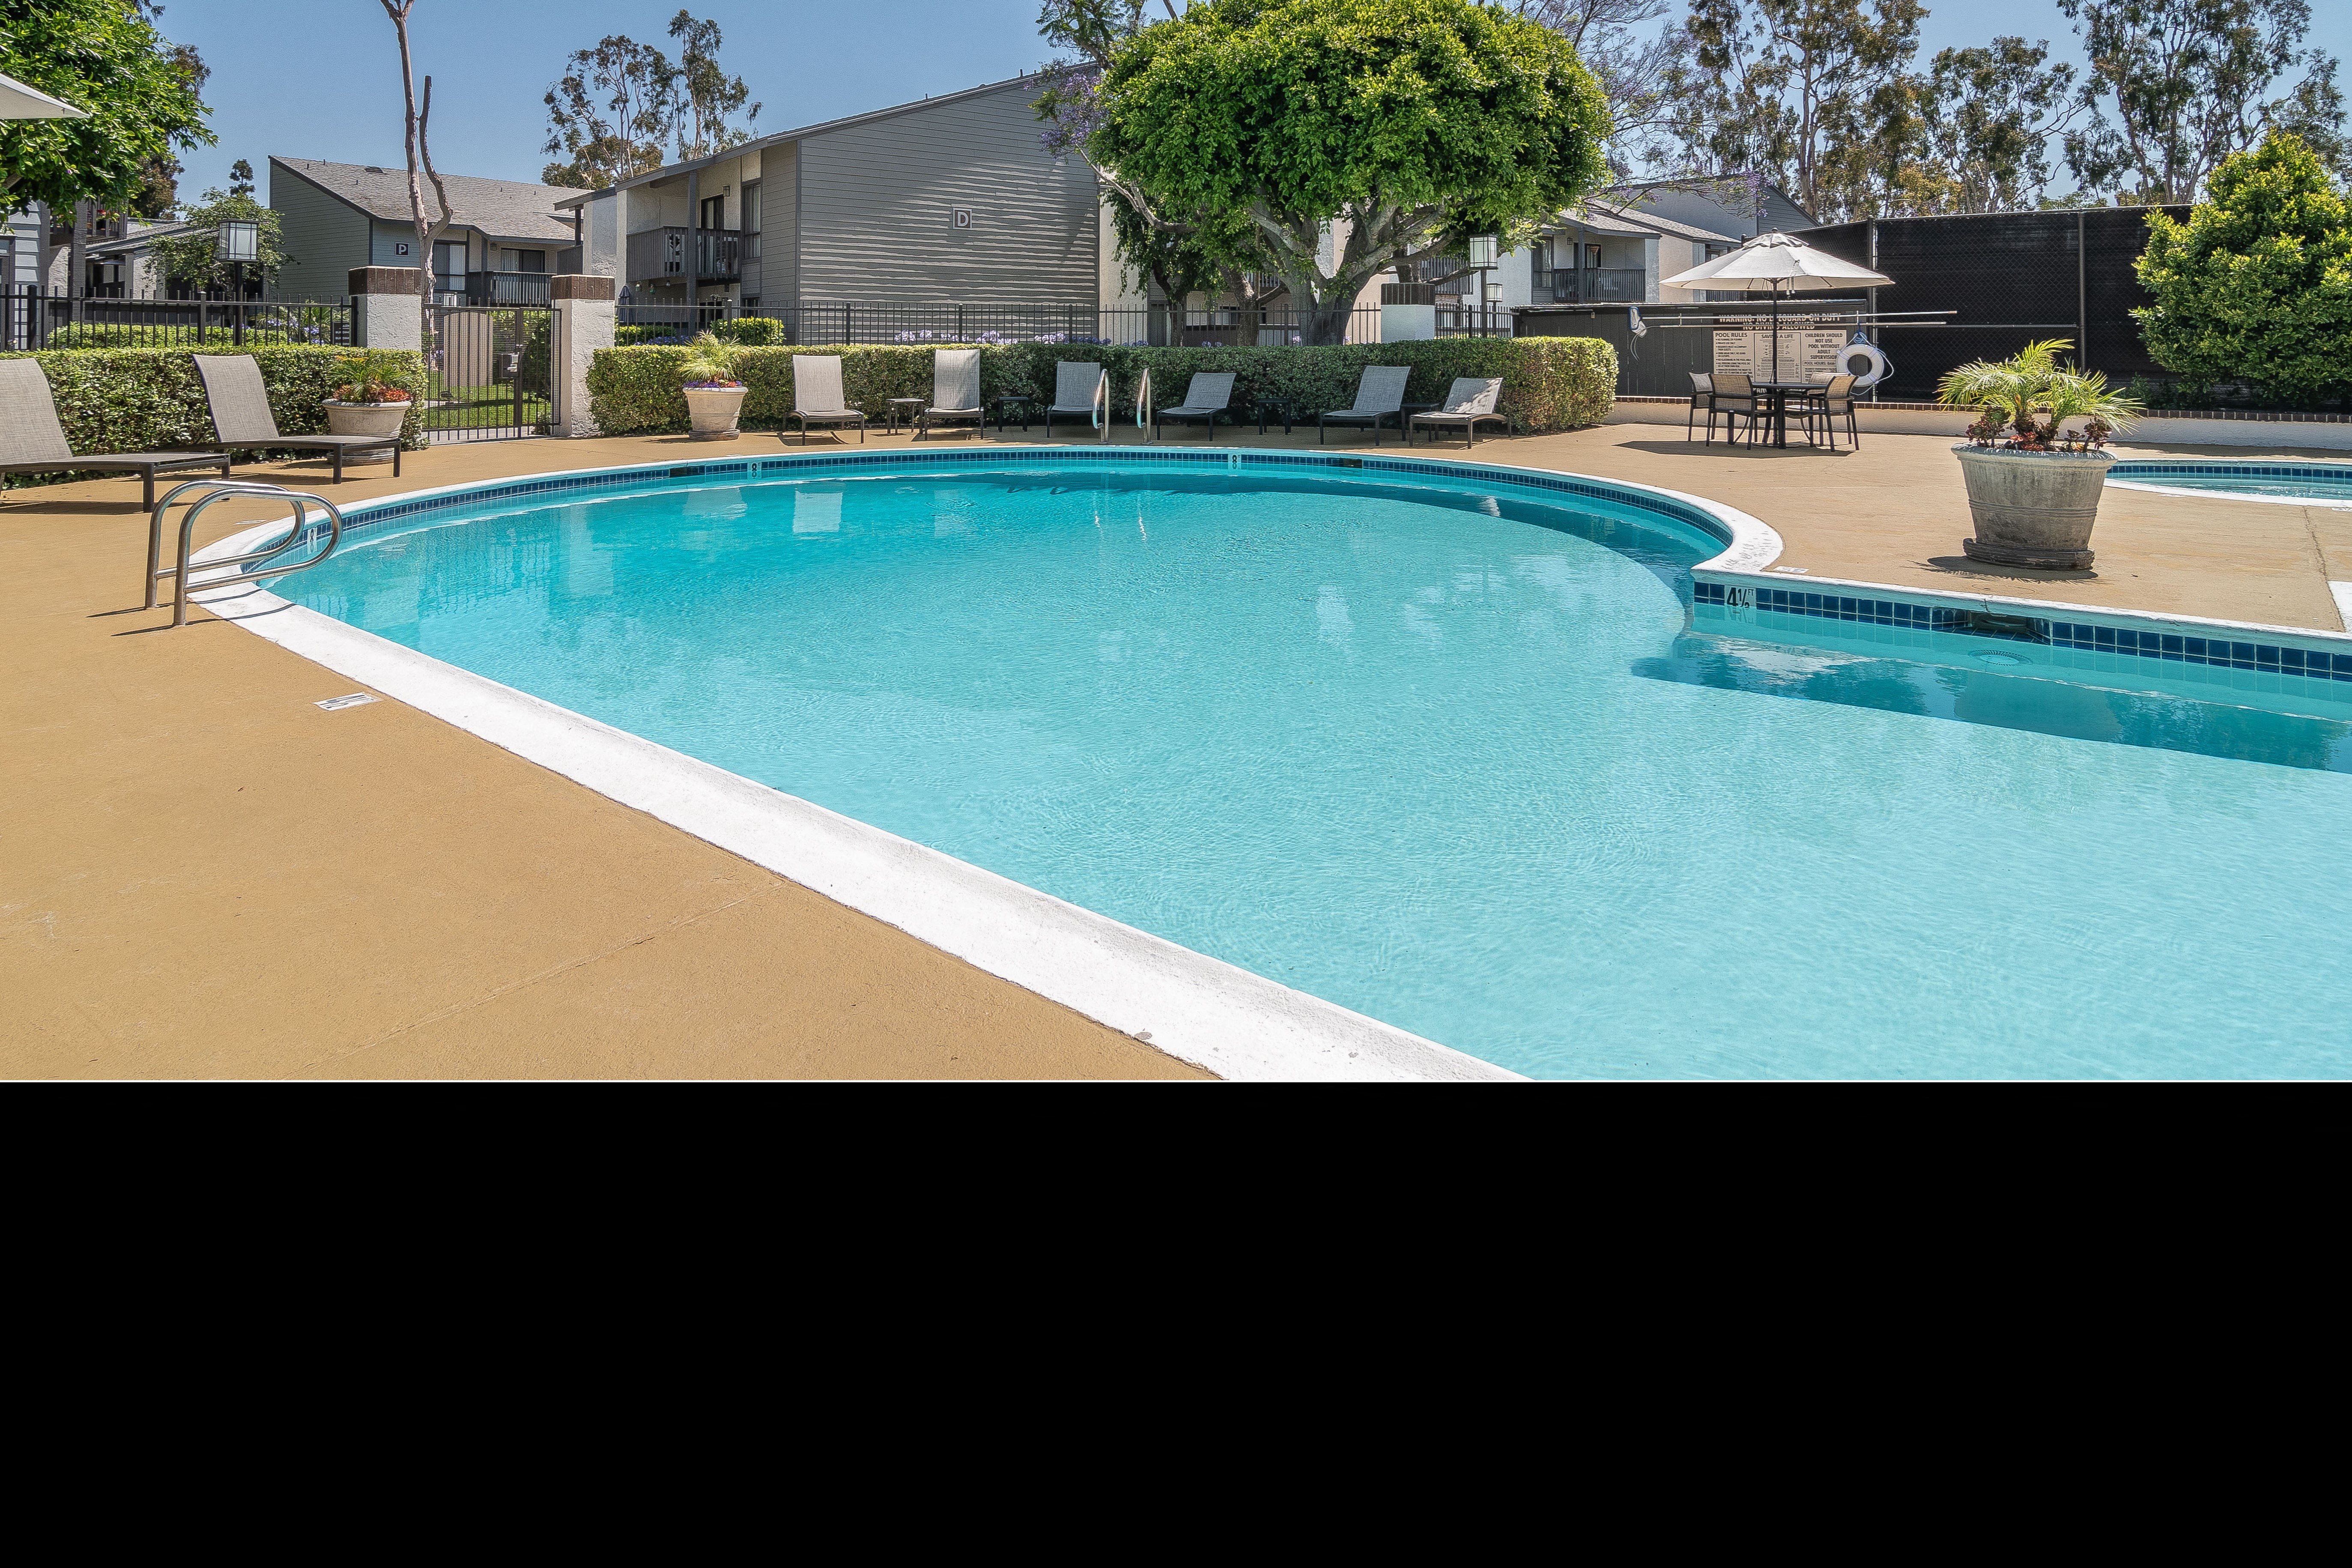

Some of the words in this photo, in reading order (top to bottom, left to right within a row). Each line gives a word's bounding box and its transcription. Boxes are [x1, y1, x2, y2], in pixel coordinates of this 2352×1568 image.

[958, 212, 969, 227] D
[399, 245, 406, 254] P
[1232, 455, 1237, 463] 8
[752, 463, 757, 471] 8
